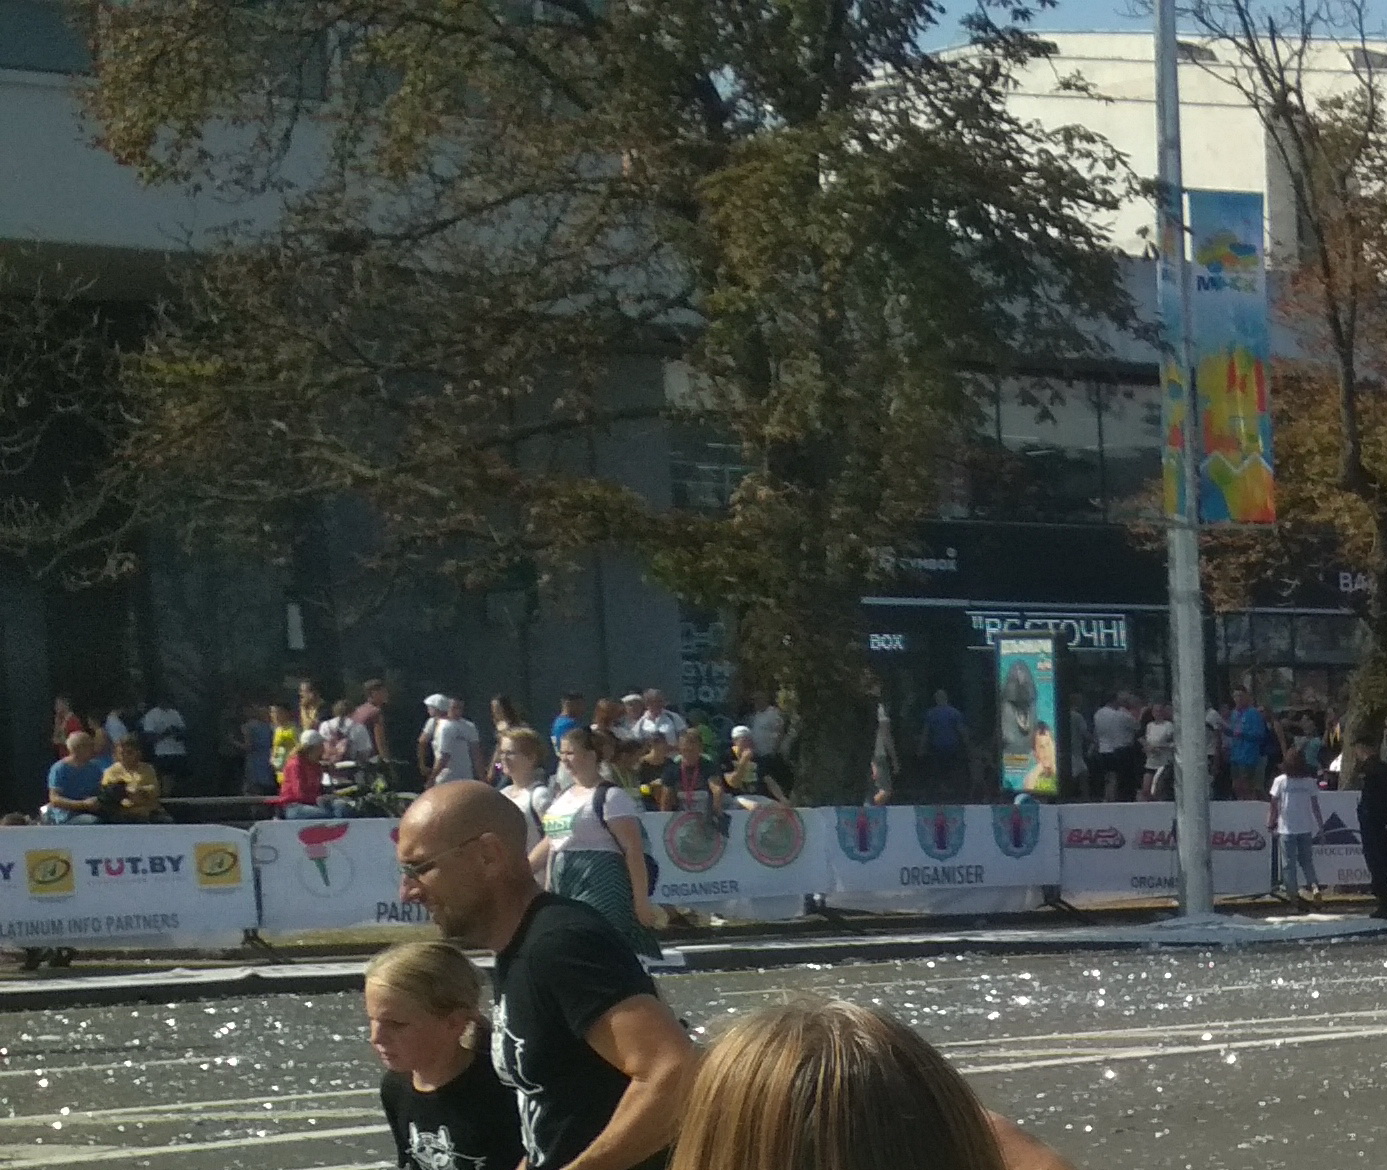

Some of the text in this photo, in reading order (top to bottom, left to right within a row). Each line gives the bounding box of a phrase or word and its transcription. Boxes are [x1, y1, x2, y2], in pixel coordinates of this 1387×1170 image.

[85, 855, 184, 876] TUT.BY
[901, 864, 985, 886] ORGANISER
[661, 880, 739, 898] ORGANISER
[0, 913, 180, 938] LATINUM INFO PARTNERS
